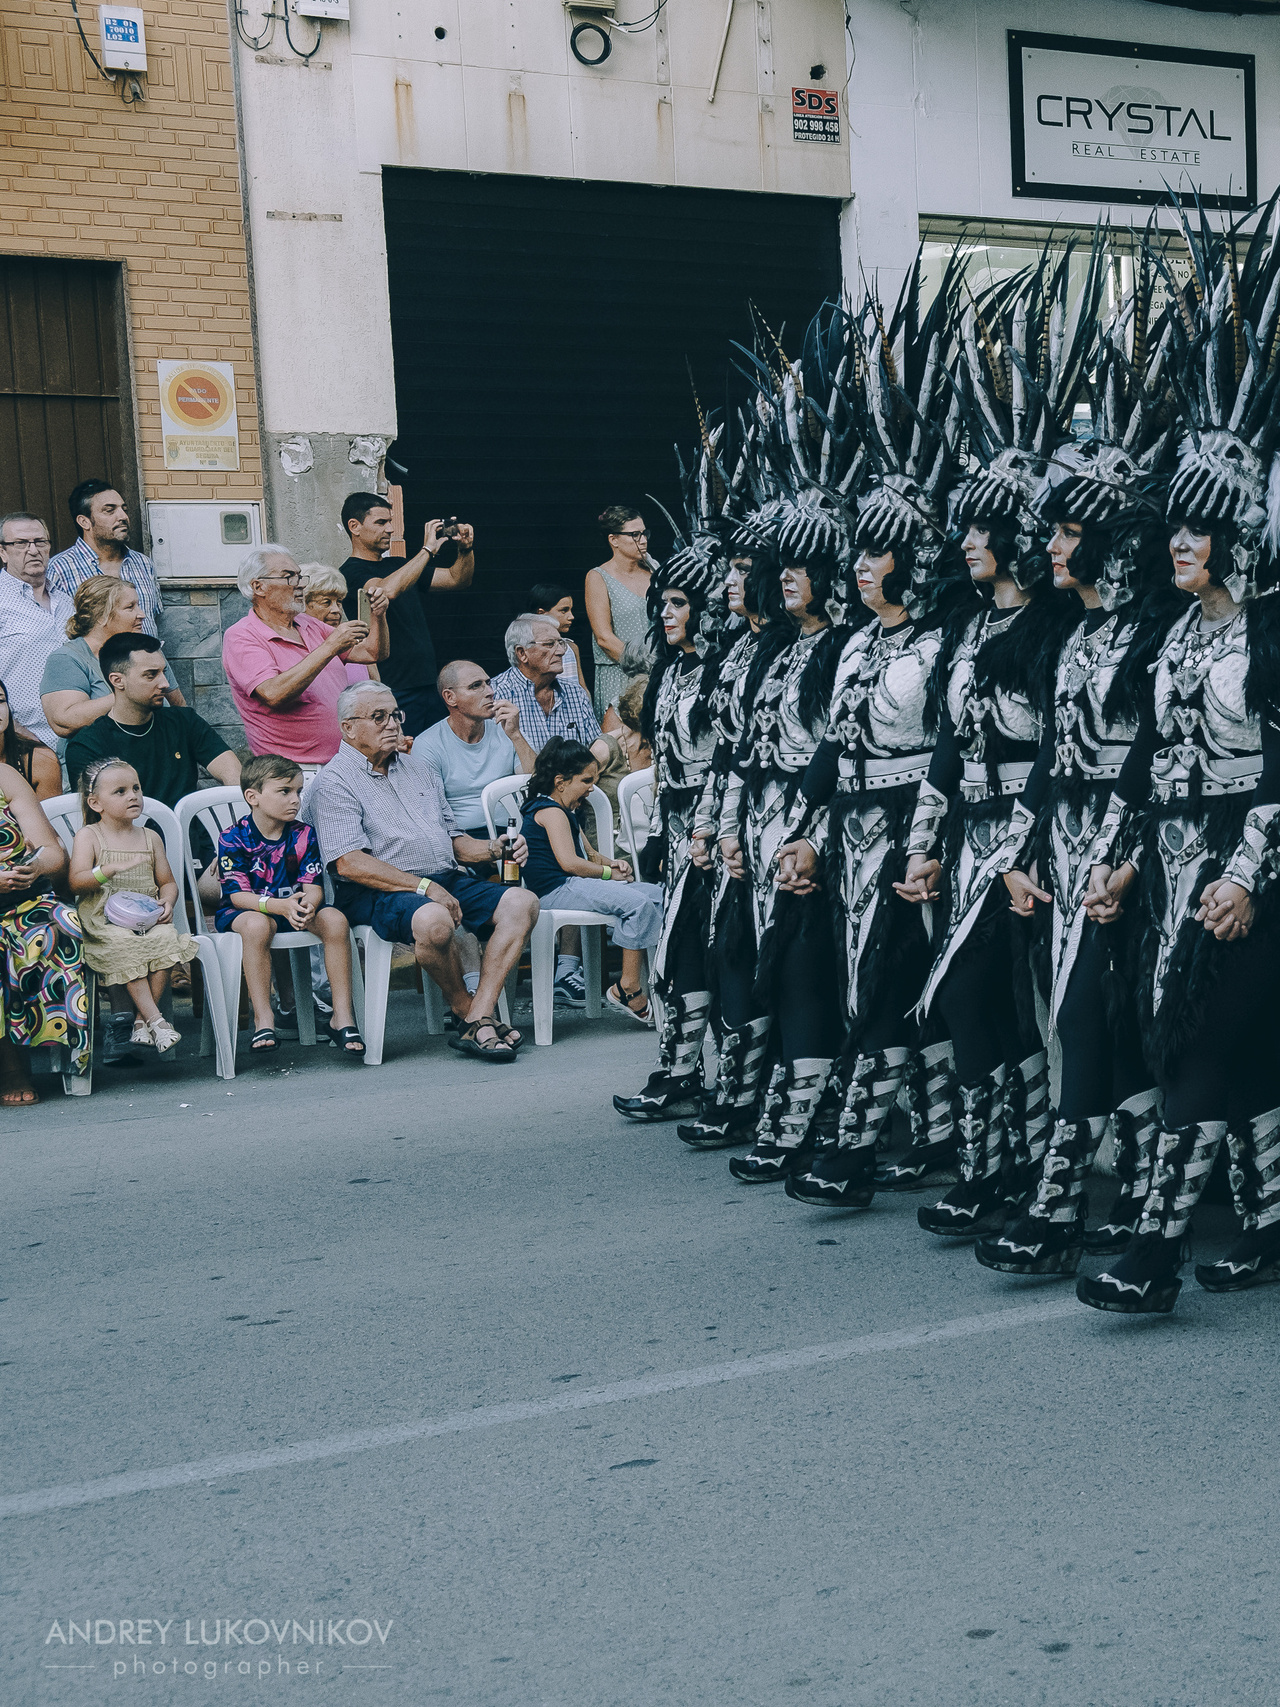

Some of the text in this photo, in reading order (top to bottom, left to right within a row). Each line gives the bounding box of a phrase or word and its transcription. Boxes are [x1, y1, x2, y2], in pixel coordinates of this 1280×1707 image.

[794, 89, 837, 115] SDS
[794, 119, 839, 133] 902 998 458
[1037, 95, 1232, 141] CRYSTAL
[795, 132, 826, 140] PROTEGIDO
[1072, 143, 1200, 164] REAL ESTATE
